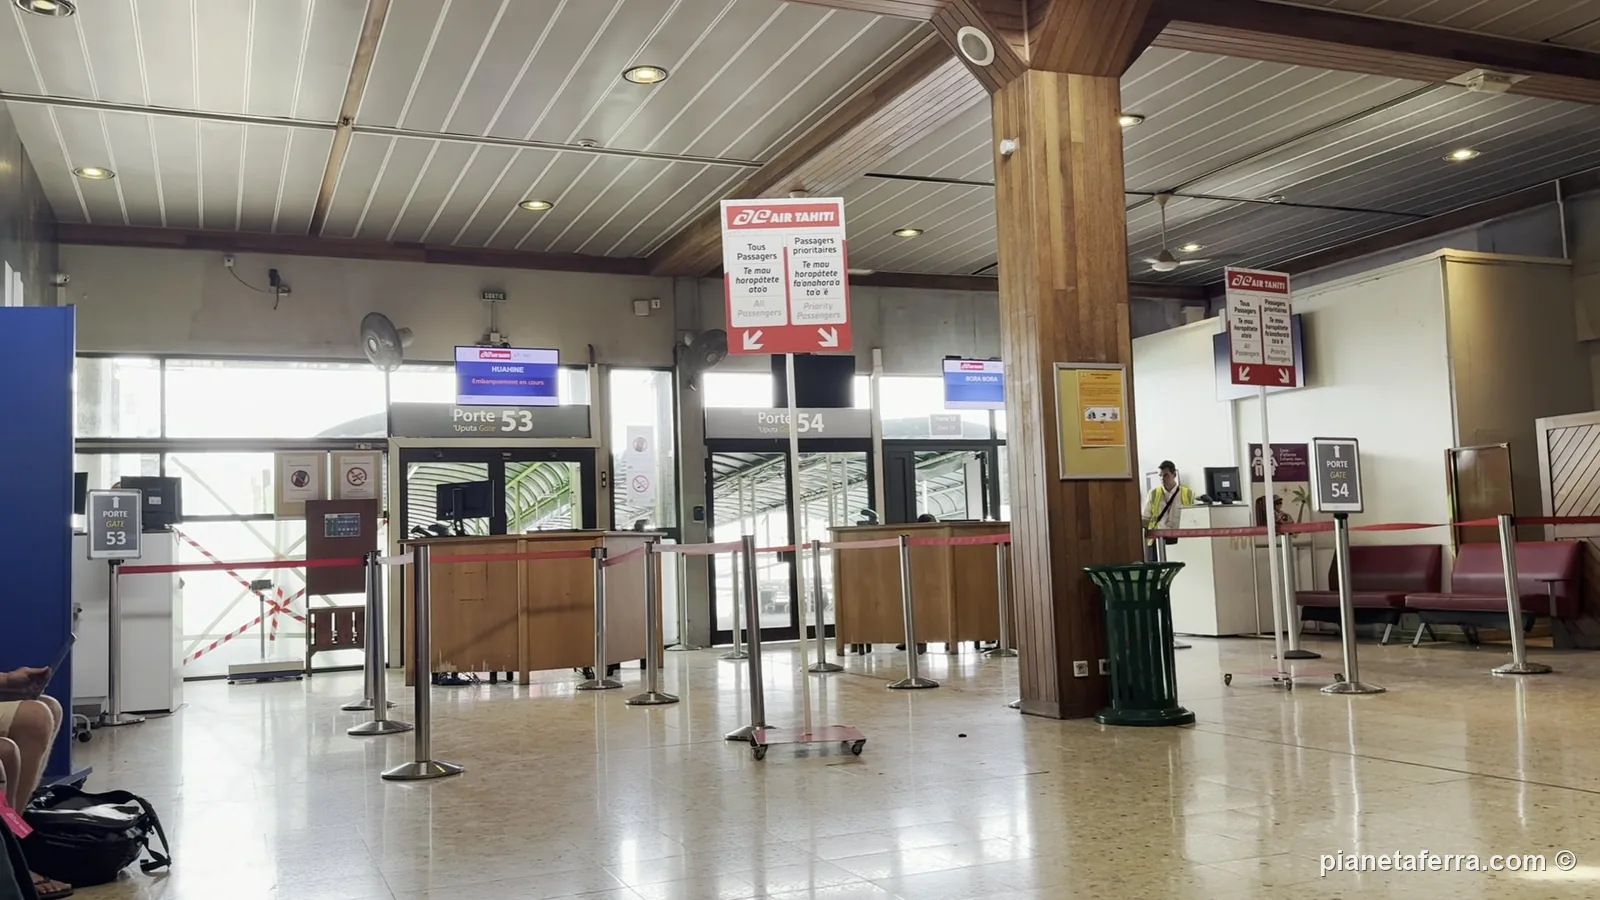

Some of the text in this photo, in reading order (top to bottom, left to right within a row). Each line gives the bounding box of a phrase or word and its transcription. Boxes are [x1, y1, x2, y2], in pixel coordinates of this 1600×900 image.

[770, 211, 835, 223] AIR TAHITI
[794, 237, 835, 247] Passagers
[747, 243, 766, 251] Tous
[793, 246, 837, 255] prioritaires
[737, 252, 777, 262] Passagers
[802, 261, 812, 269] Te
[743, 267, 753, 275] Te
[1251, 279, 1286, 290] AIR TAHITI
[803, 302, 834, 311] Priority
[737, 309, 782, 318] Passengers
[796, 312, 840, 320] Passengers
[491, 365, 525, 373] HUAHINE
[472, 378, 519, 386] Embarquement
[453, 408, 533, 432] Porte 53
[758, 412, 825, 433] Porte 54
[479, 424, 496, 432] Gate
[1326, 460, 1348, 468] PORTE
[1330, 471, 1347, 479] GATE
[1331, 482, 1350, 498] 54
[102, 510, 128, 518] PORTE
[105, 520, 124, 528] GATE
[106, 531, 127, 545] 53
